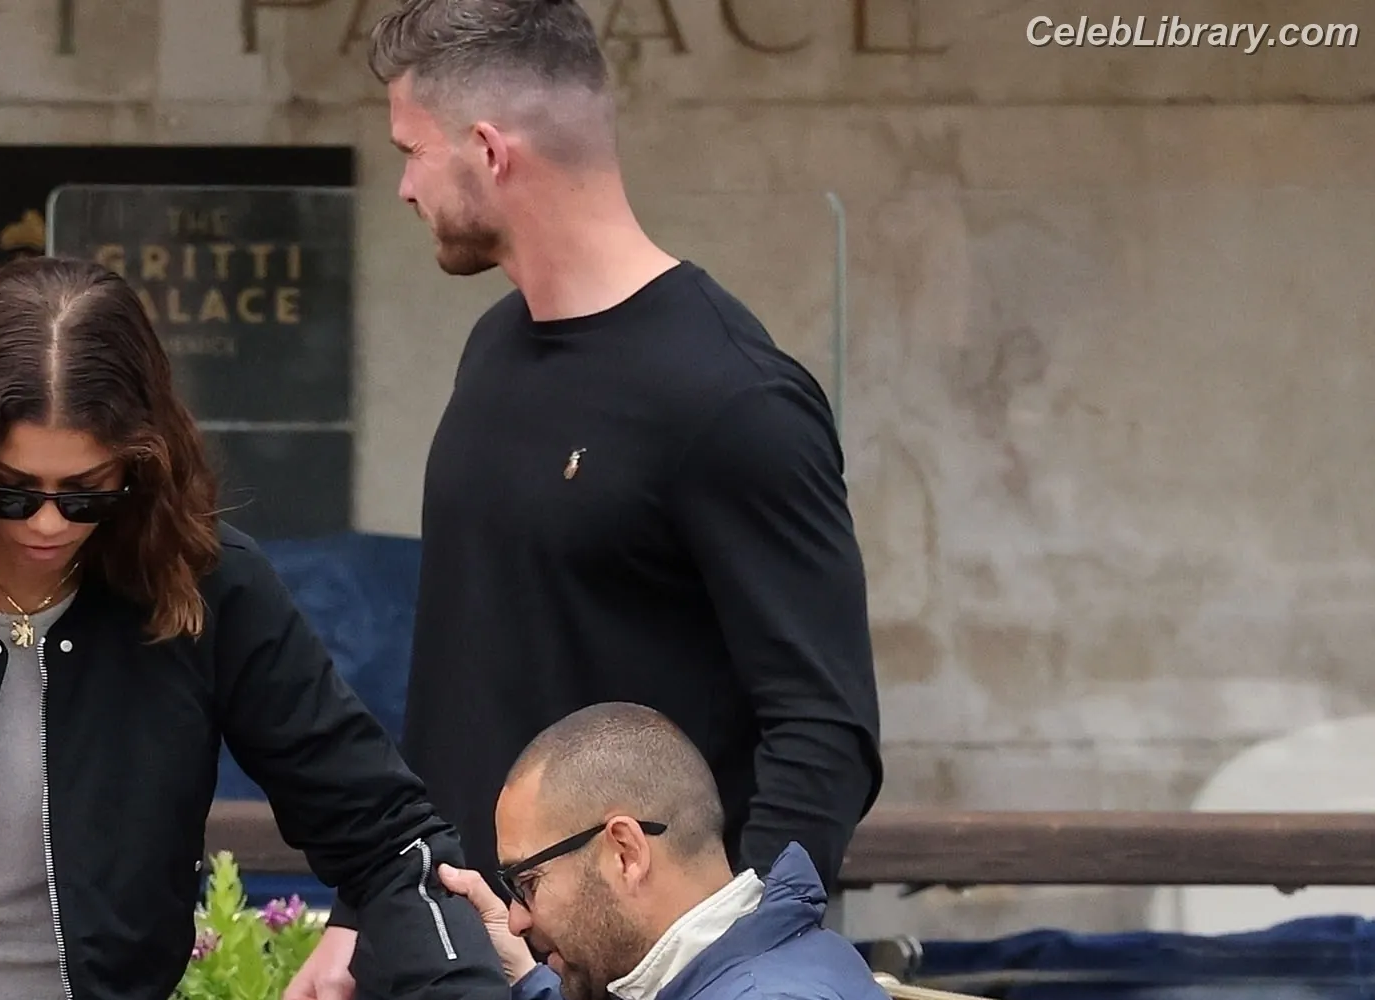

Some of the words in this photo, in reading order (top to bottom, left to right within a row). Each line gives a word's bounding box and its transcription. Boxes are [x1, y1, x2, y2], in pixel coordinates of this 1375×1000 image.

[167, 208, 228, 236] THE
[93, 243, 303, 280] GRITTI
[139, 287, 301, 324] ALACE
